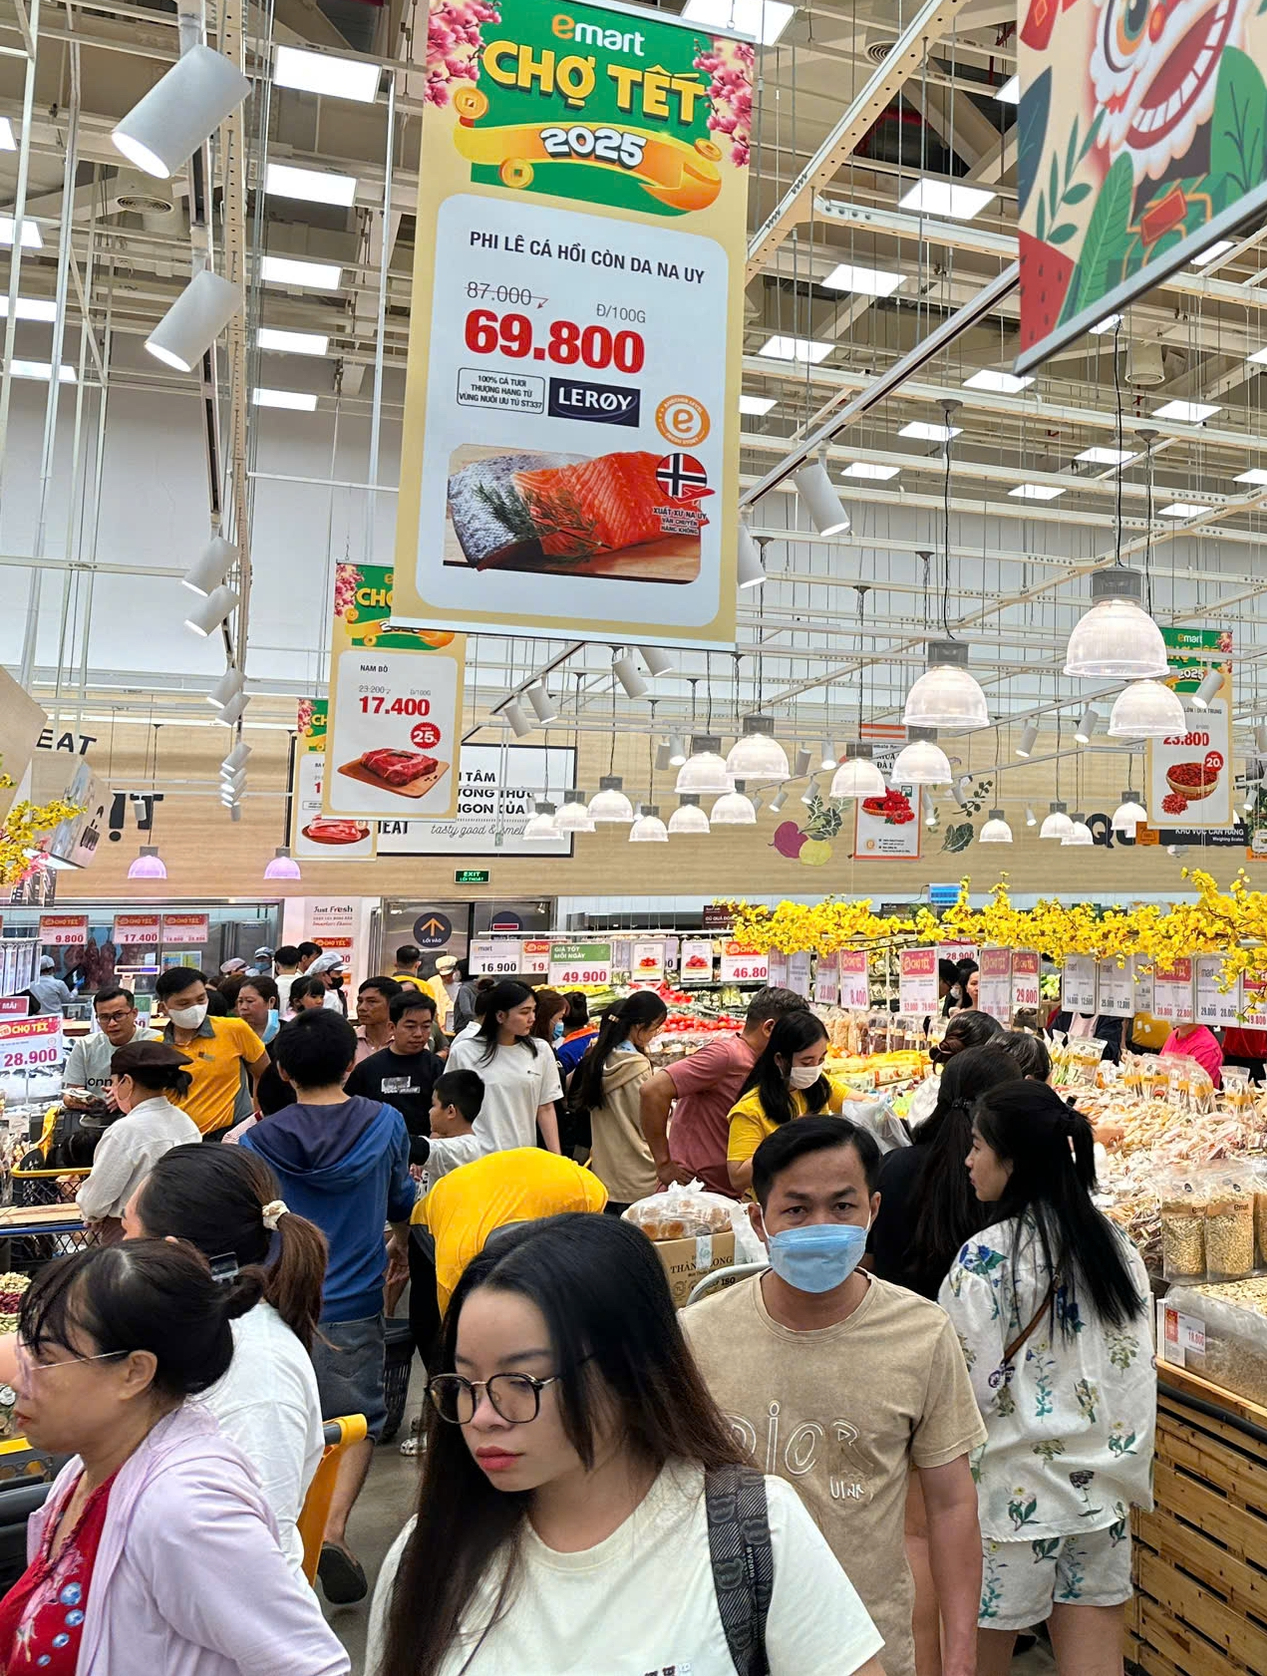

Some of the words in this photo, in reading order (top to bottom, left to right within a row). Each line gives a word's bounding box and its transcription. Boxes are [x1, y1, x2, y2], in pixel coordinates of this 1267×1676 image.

[552, 14, 646, 56] emart
[482, 40, 596, 109] CHỢ
[607, 64, 705, 126] TẾT
[540, 126, 647, 168] 2025
[470, 230, 499, 251] PHI
[504, 235, 525, 254] LÊ
[530, 237, 553, 258] CÁ
[557, 240, 586, 264] HỒI
[591, 247, 625, 270] CÒN
[630, 257, 653, 275] DA
[657, 262, 680, 280] NA
[684, 267, 706, 284] UY
[465, 308, 645, 374] 69.800
[558, 386, 633, 411] LERØY
[359, 696, 430, 716] 17.400
[36, 728, 97, 755] EAT
[466, 770, 496, 782] TÂM
[431, 824, 459, 838] tasty
[460, 826, 486, 838] good
[55, 934, 84, 943] 9.800
[124, 933, 158, 942] 17.400
[481, 962, 517, 972] 16.900
[733, 966, 767, 978] 46.80
[562, 971, 607, 983] 49.900
[11, 1023, 32, 1035] CHỢ
[32, 1020, 49, 1033] TẾT
[4, 1049, 58, 1068] 28.900
[711, 1256, 733, 1266] ONG
[721, 1277, 736, 1285] ISO
